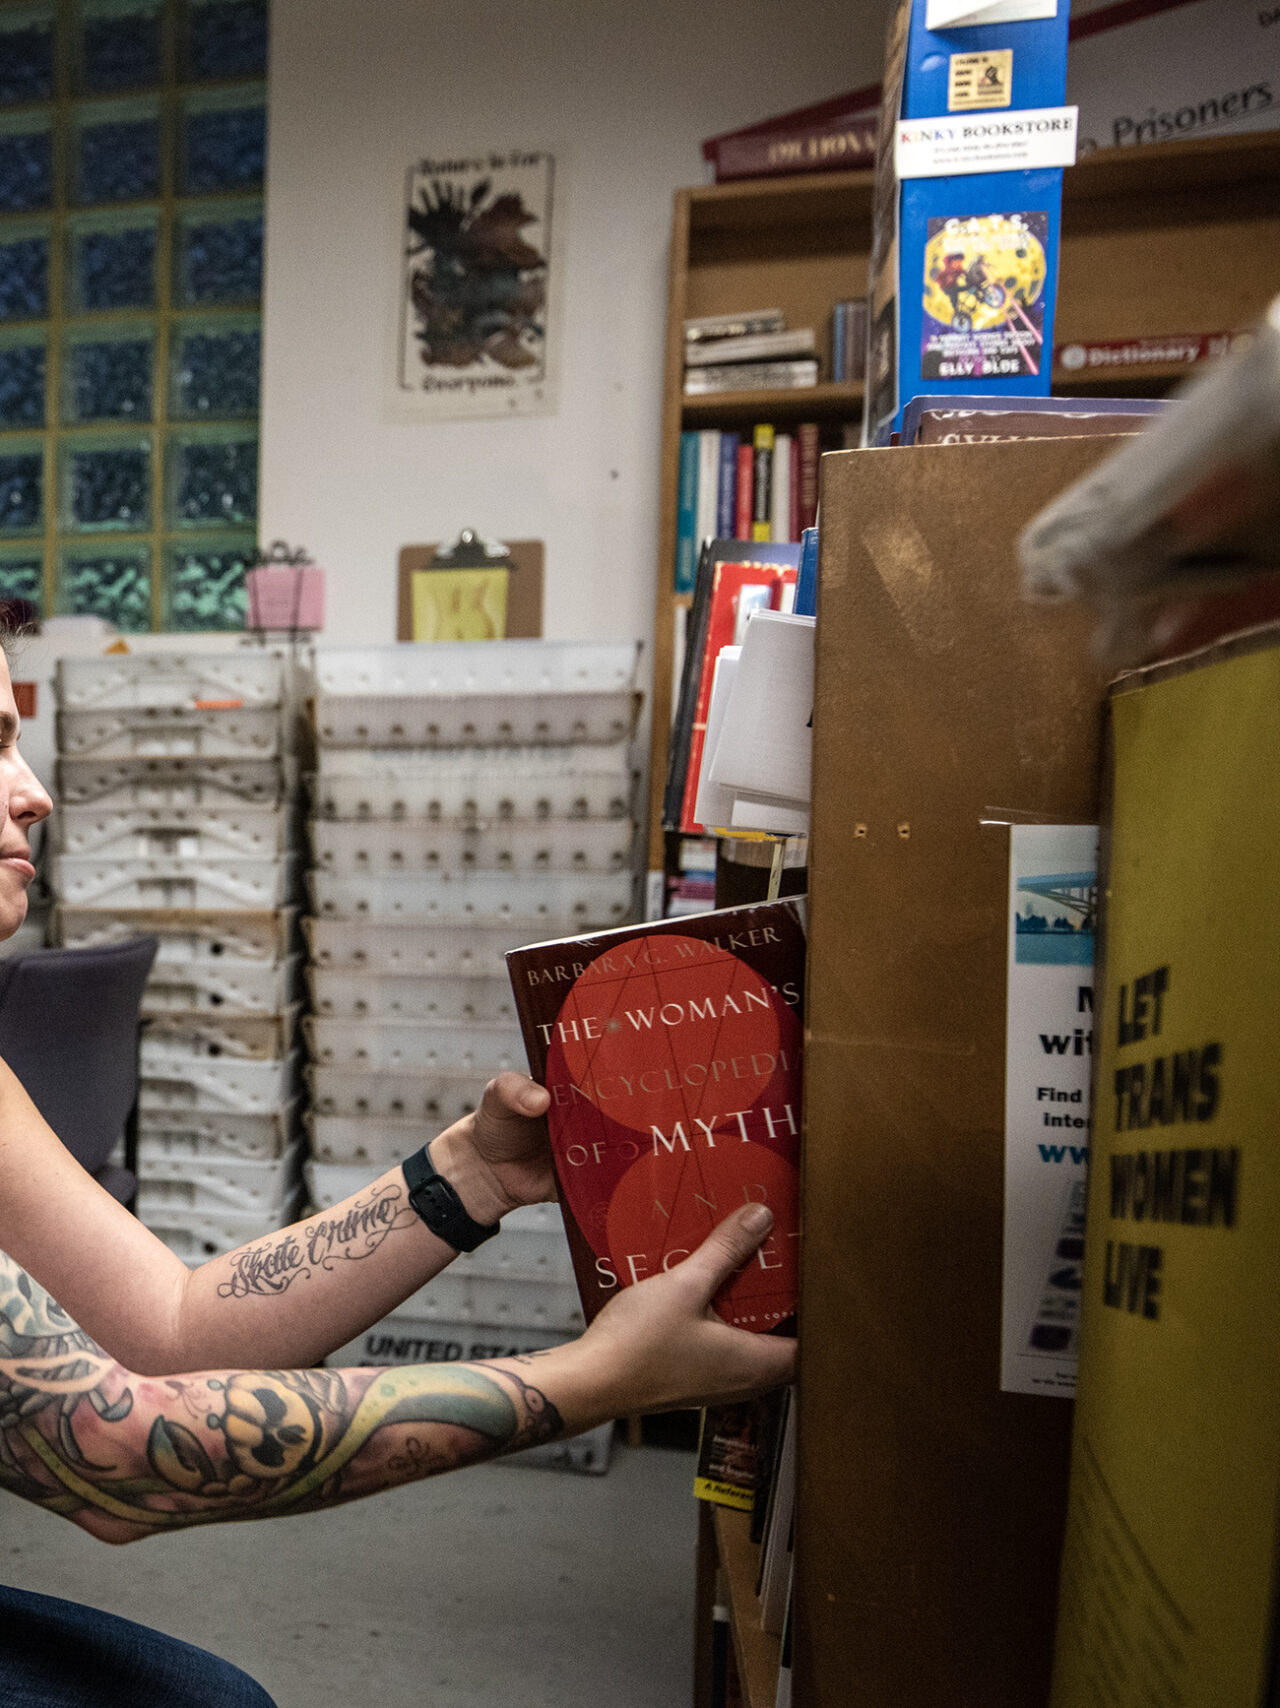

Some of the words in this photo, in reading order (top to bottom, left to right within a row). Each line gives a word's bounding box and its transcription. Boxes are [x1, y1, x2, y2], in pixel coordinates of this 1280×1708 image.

[900, 128, 957, 145] KINKY
[962, 117, 1074, 139] BOOKSTORE
[1111, 81, 1274, 148] Prisoners
[939, 359, 975, 377] ELLY
[981, 357, 1021, 376] BLUE
[1088, 346, 1200, 366] Dictionary
[527, 951, 638, 988] BARBARA
[644, 947, 668, 967] G.
[677, 926, 782, 962] WALKER
[537, 1016, 602, 1047] THE
[623, 981, 801, 1032] WOMAN'S
[1115, 965, 1173, 1049] LET
[1039, 1029, 1092, 1056] wit
[551, 1049, 803, 1108] ENCYCLOPEDI
[1037, 1086, 1083, 1104] Find
[1113, 1042, 1223, 1133] TRANS
[566, 1140, 609, 1168] OF
[649, 1103, 799, 1158] MYTH
[1037, 1142, 1090, 1166] ww
[650, 1184, 769, 1220] AND
[1109, 1144, 1241, 1230] WOMEN
[226, 1234, 308, 1296] Skate
[306, 1196, 400, 1266] Crime
[1102, 1239, 1164, 1321] LIVE
[365, 1335, 464, 1362] UNITED
[714, 1484, 754, 1501] Referen
